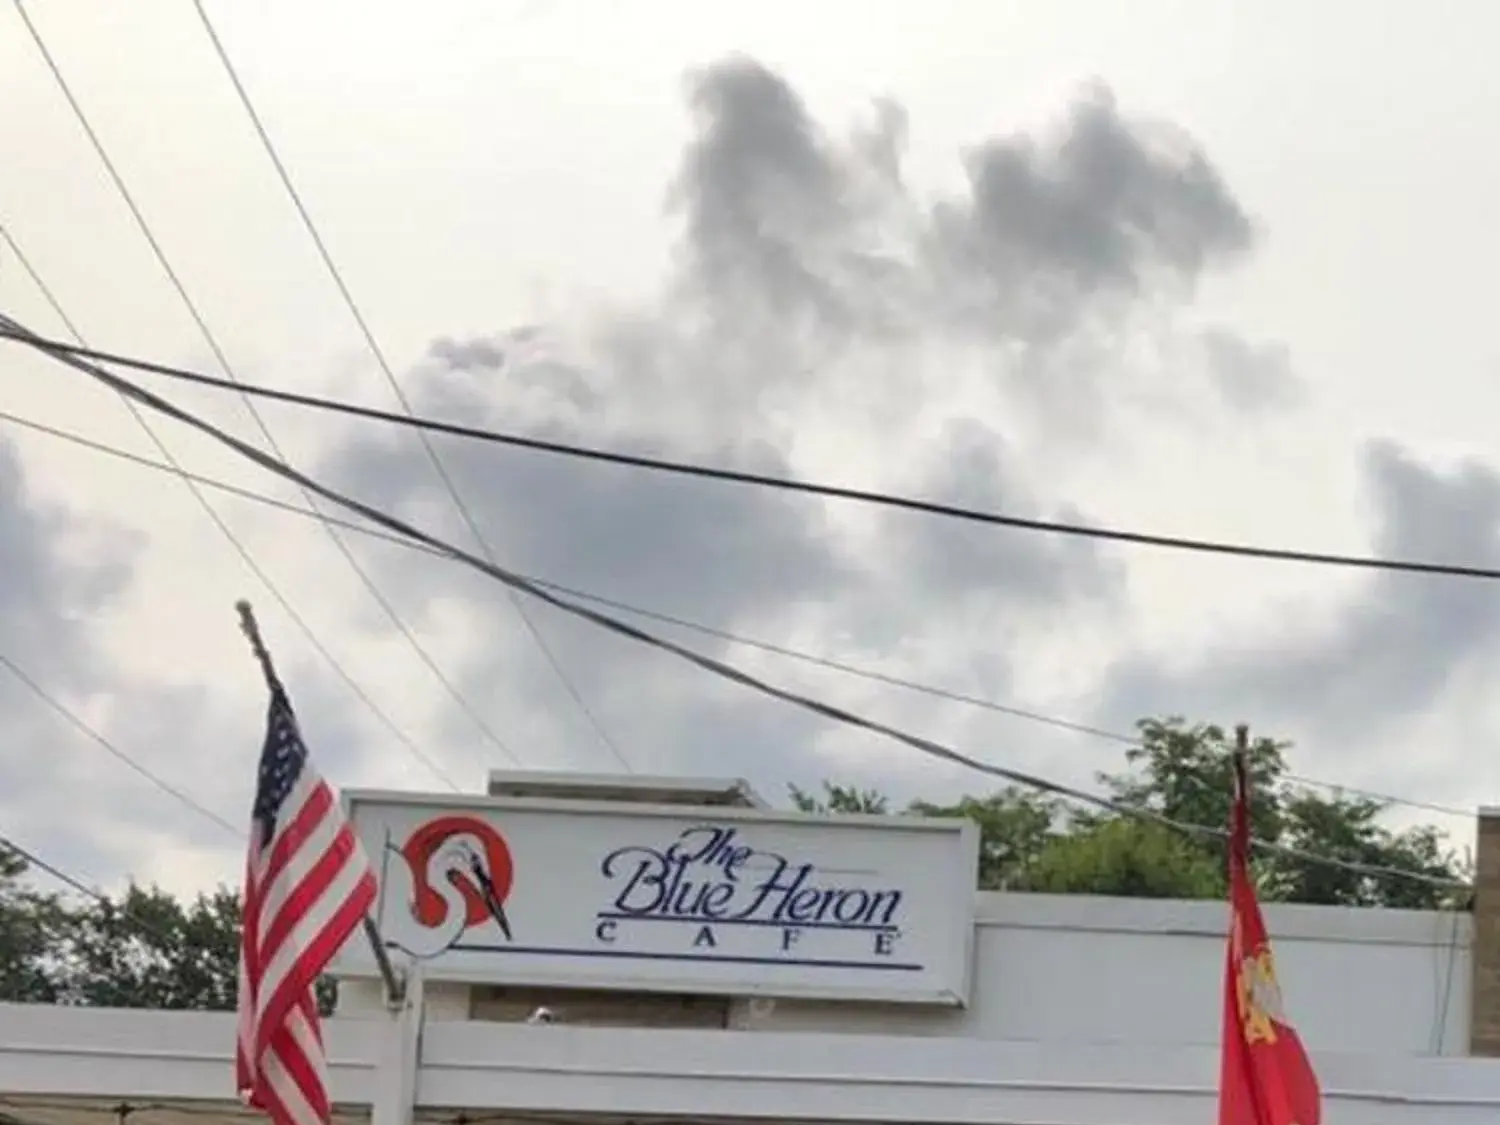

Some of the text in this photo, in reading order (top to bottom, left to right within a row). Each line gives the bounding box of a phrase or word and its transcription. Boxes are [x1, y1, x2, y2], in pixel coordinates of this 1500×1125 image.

[602, 846, 903, 922] Blue Heron
[667, 826, 754, 881] The
